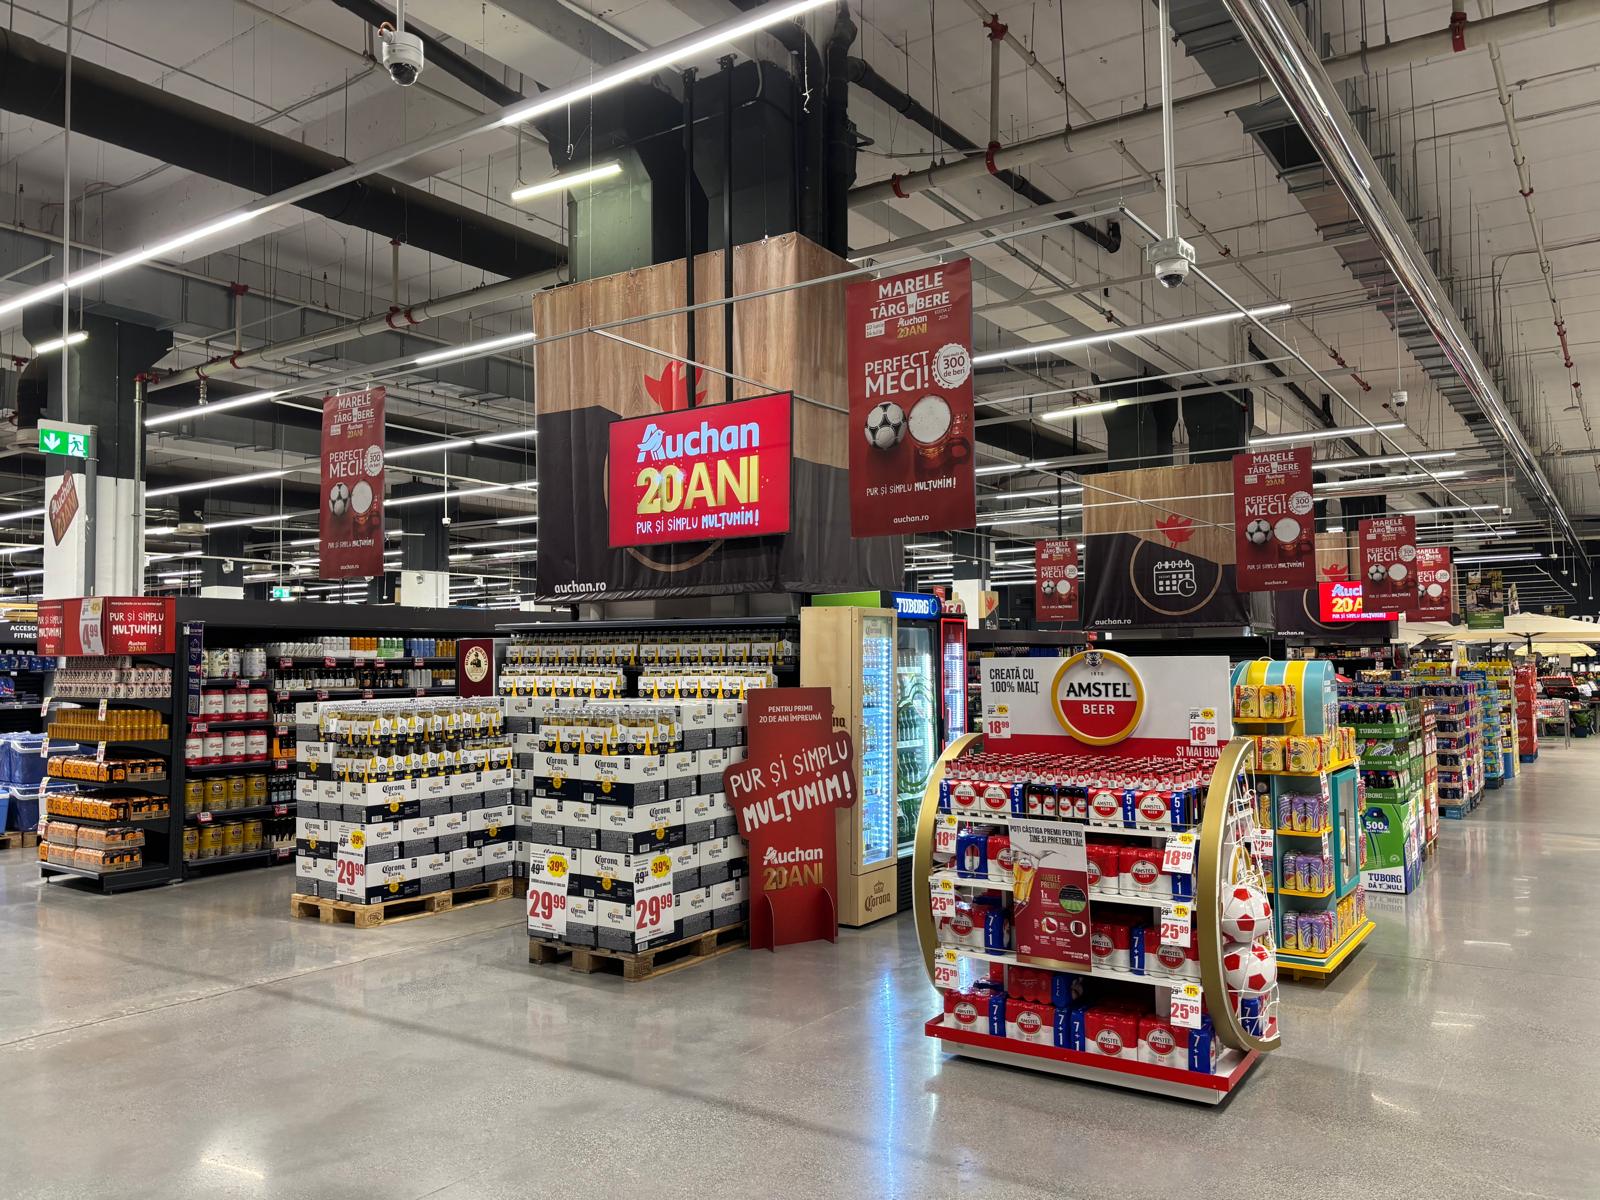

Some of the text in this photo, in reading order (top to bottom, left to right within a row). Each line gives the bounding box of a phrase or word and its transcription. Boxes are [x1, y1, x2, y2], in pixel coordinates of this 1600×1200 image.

[879, 272, 944, 299] MARELE
[870, 291, 950, 320] TÂRG BERE
[898, 316, 928, 328] Auchan
[865, 350, 930, 376] PERFECT
[944, 356, 965, 369] 300
[953, 368, 965, 376] beri
[866, 365, 929, 398] MECI!
[338, 393, 371, 409] MARELE
[334, 408, 374, 424] TÂRG BERE
[637, 422, 760, 463] Auchan
[330, 449, 364, 462] PERFECT
[1253, 452, 1294, 464] MARELE
[330, 459, 362, 478] MECI!
[1248, 463, 1299, 474] TÂRG BERE
[866, 487, 879, 496] PUR
[1245, 494, 1287, 504] PERFECT
[1245, 501, 1286, 516] MECI!
[893, 514, 930, 524] auchan.ro
[637, 522, 651, 534] PUR
[1368, 551, 1398, 563] MECI!
[554, 580, 607, 594] auchan.ro
[897, 597, 929, 613] TUBORG
[110, 612, 124, 622] PUR
[989, 667, 1034, 680] CREATĂ CU
[991, 681, 1015, 693] 100%
[1066, 682, 1132, 698] AMSTEL
[1082, 704, 1115, 715] BEER
[306, 744, 320, 752] Corona
[1186, 746, 1202, 757] MAI
[546, 756, 568, 766] Corona
[594, 760, 618, 770] Corona
[382, 784, 405, 793] Corona
[730, 768, 766, 798] PUR
[483, 812, 502, 820] Corona
[650, 806, 671, 817] Corona
[610, 815, 626, 823] Corona
[305, 822, 320, 830] Corona
[1366, 821, 1388, 830] 500x
[594, 855, 618, 865] Corona
[763, 847, 823, 865] Auchan
[382, 864, 405, 873] Corona
[547, 860, 566, 872] -39%
[651, 861, 669, 874] -39%
[1368, 873, 1402, 883] TUBORG
[865, 892, 891, 912] Corona
[570, 907, 586, 915] Corona
[607, 912, 624, 920] Corona
[1174, 908, 1187, 916] -11%
[1184, 987, 1198, 996] -11%
